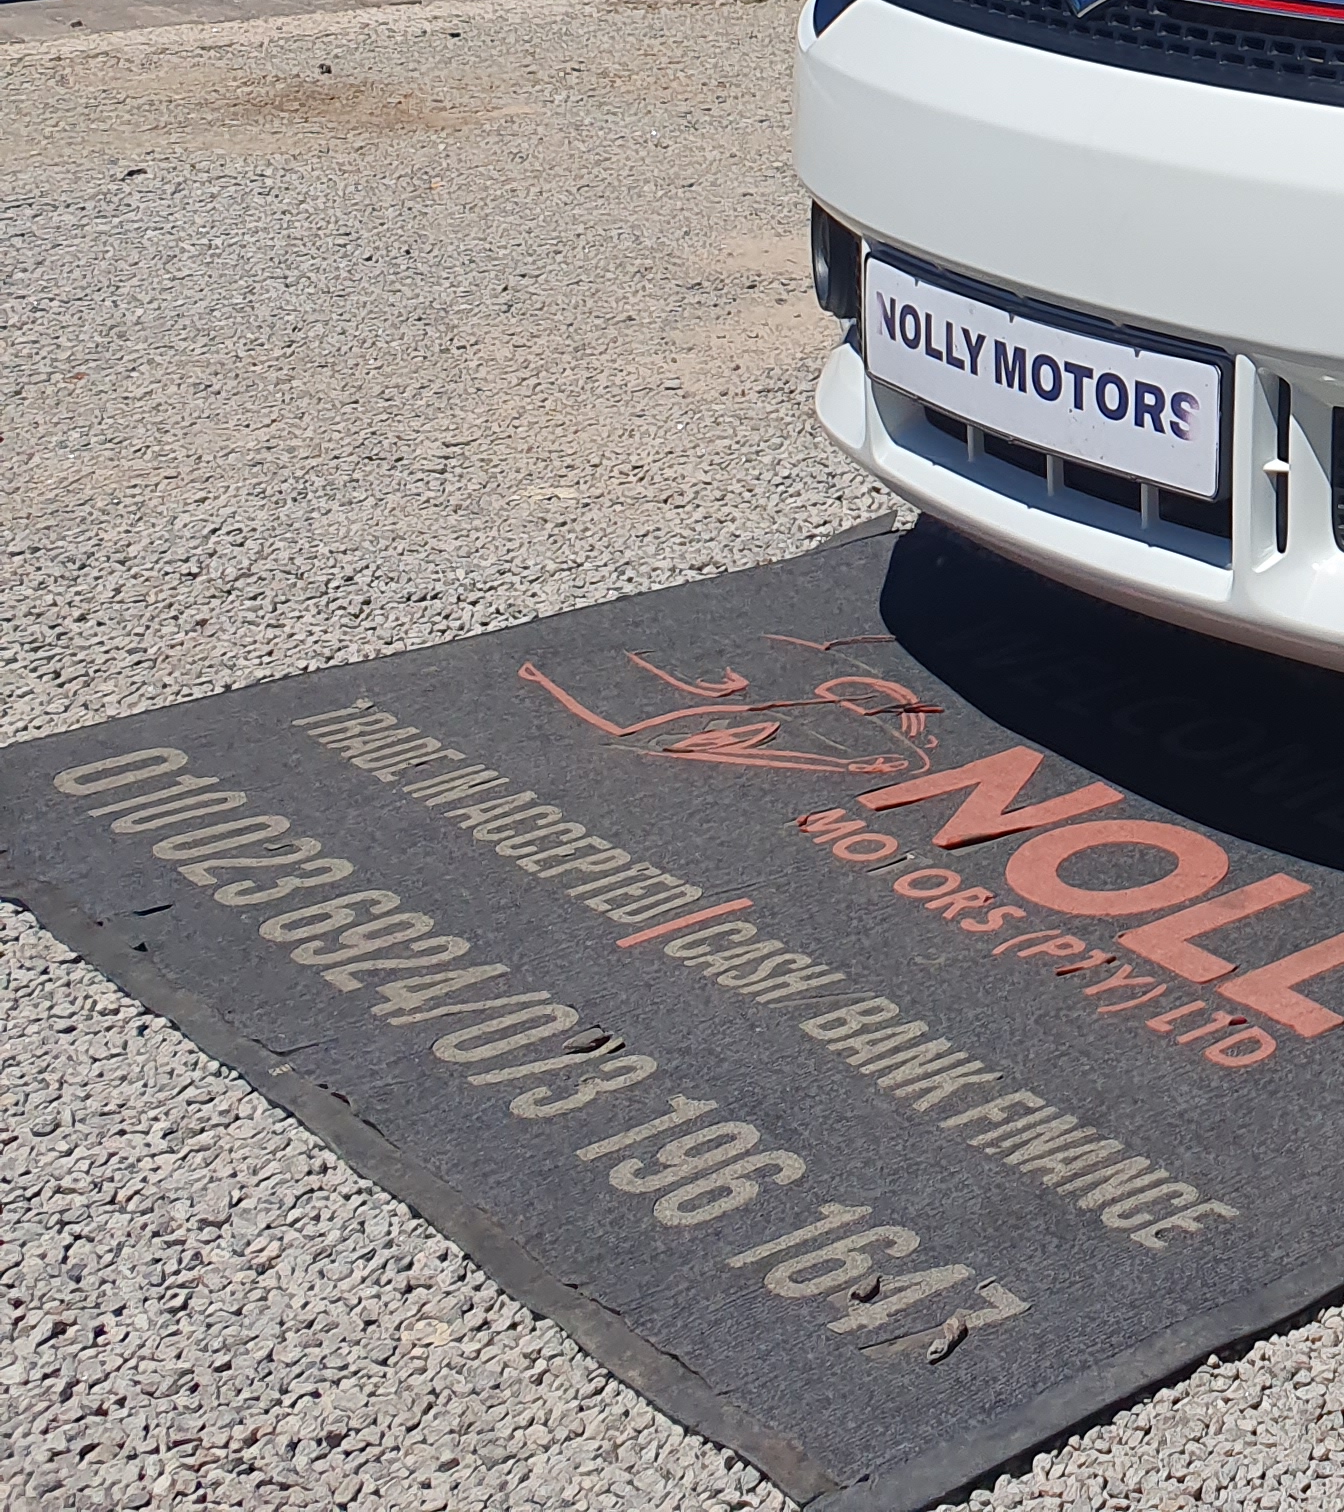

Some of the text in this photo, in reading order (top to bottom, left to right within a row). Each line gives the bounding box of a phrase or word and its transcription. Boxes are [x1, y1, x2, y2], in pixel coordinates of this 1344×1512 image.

[875, 290, 1200, 441] NOLLY MOTORS
[292, 698, 466, 783] TRADE
[402, 764, 510, 807] IN
[443, 790, 703, 924] ACCEPTED
[53, 747, 247, 835] 010
[152, 814, 354, 906] 023
[577, 1094, 806, 1227] 196
[1145, 1000, 1277, 1068] LTD
[940, 1090, 1239, 1251] FINANCE
